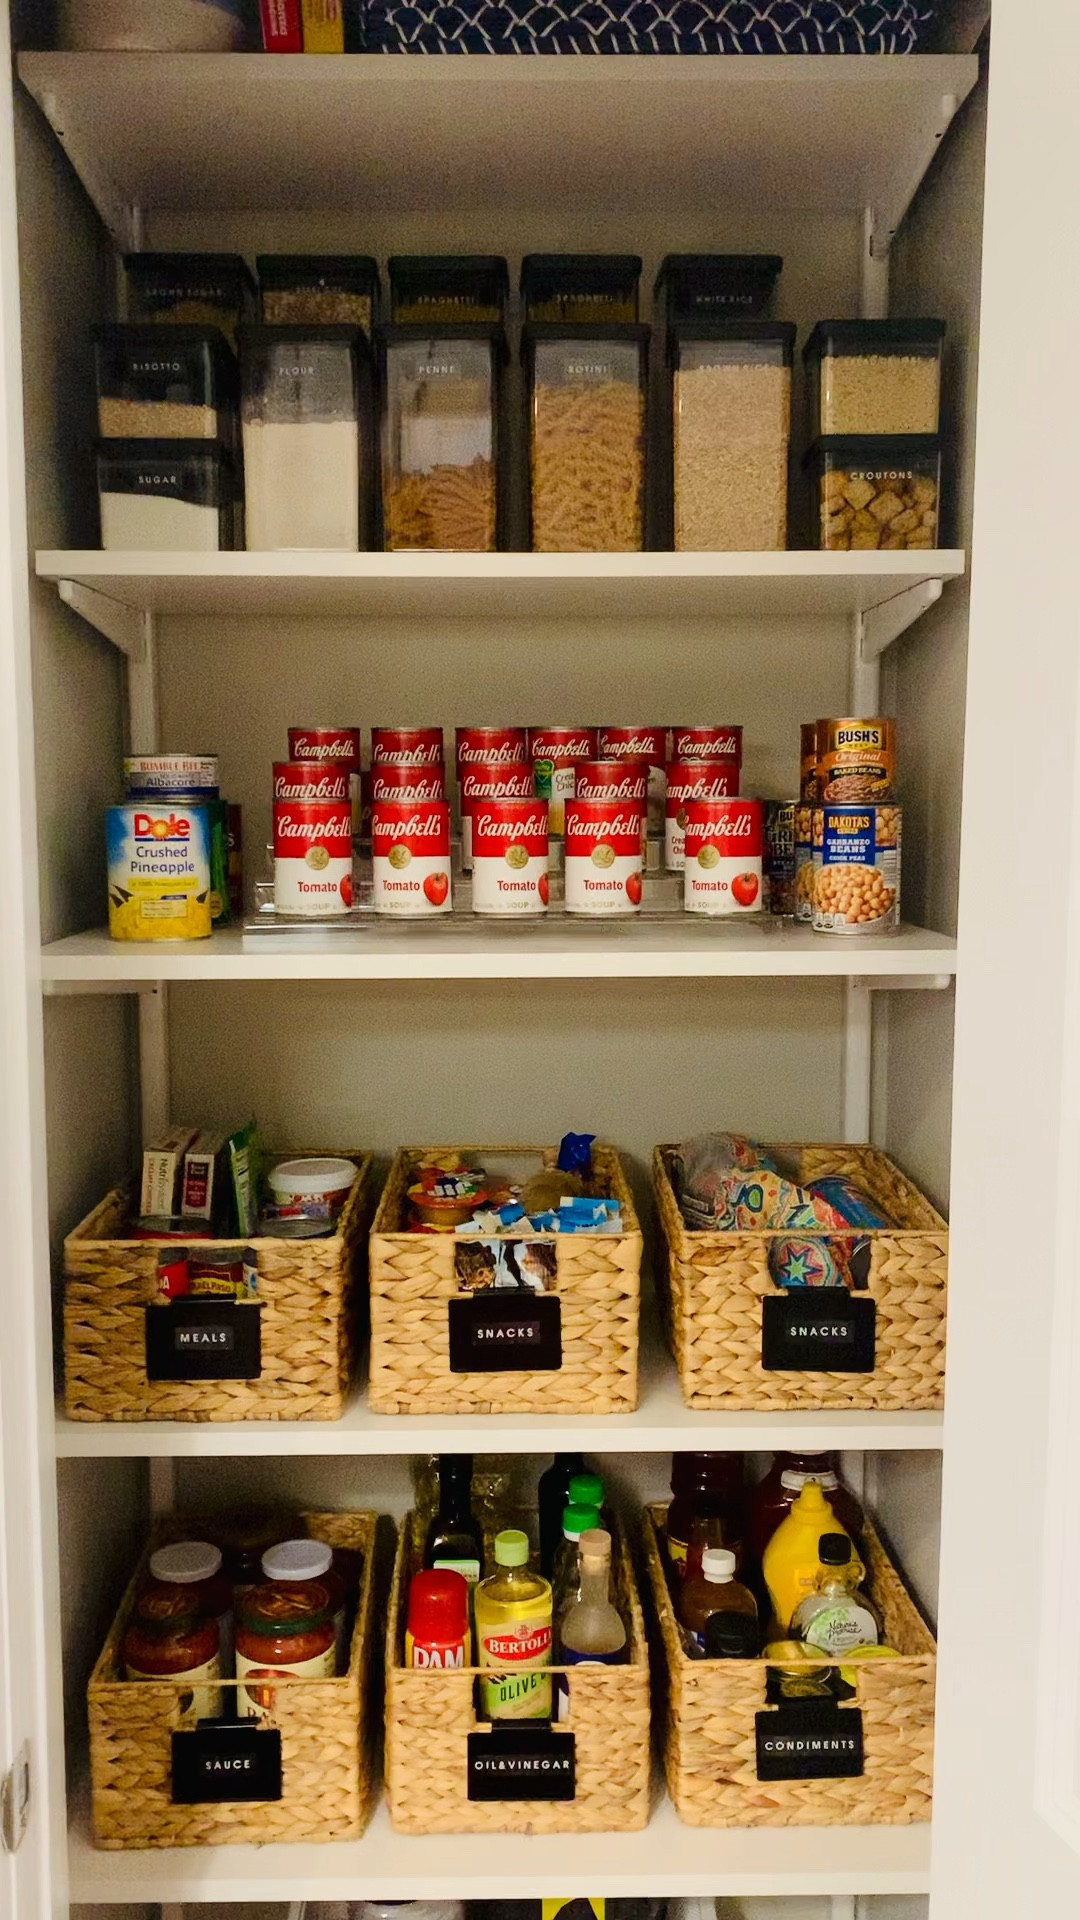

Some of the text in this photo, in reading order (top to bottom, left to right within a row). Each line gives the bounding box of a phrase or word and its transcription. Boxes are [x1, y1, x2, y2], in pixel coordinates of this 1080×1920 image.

[132, 362, 181, 372] RISOTTO
[279, 366, 315, 377] FLOUR
[419, 366, 455, 376] PENNE
[568, 363, 608, 374] ROTINI
[138, 475, 177, 485] SUGAR
[850, 470, 913, 481] CROUTONS
[677, 736, 736, 755] Campbell's
[835, 751, 881, 762] Original
[146, 777, 195, 787] Albacore
[666, 777, 728, 802] ampbell's
[134, 814, 191, 837] Dole
[828, 816, 870, 828] DAKOTA'S
[136, 846, 188, 858] Crushed
[830, 845, 866, 853] BEANS
[130, 861, 195, 875] Pineapple
[298, 881, 338, 892] Tomato
[383, 880, 420, 891] Tomato
[498, 881, 536, 891] Tomato
[584, 881, 623, 891] Tomato
[692, 880, 728, 891] Tomato
[477, 1327, 534, 1339] SNACKS
[790, 1326, 848, 1337] SNACKS
[180, 1333, 227, 1343] MEALS
[500, 1674, 536, 1701] OLIVE
[765, 1740, 855, 1750] CONDIMENTS
[205, 1759, 250, 1770] SAUCE
[474, 1759, 570, 1770] OIL&VINEGAR
